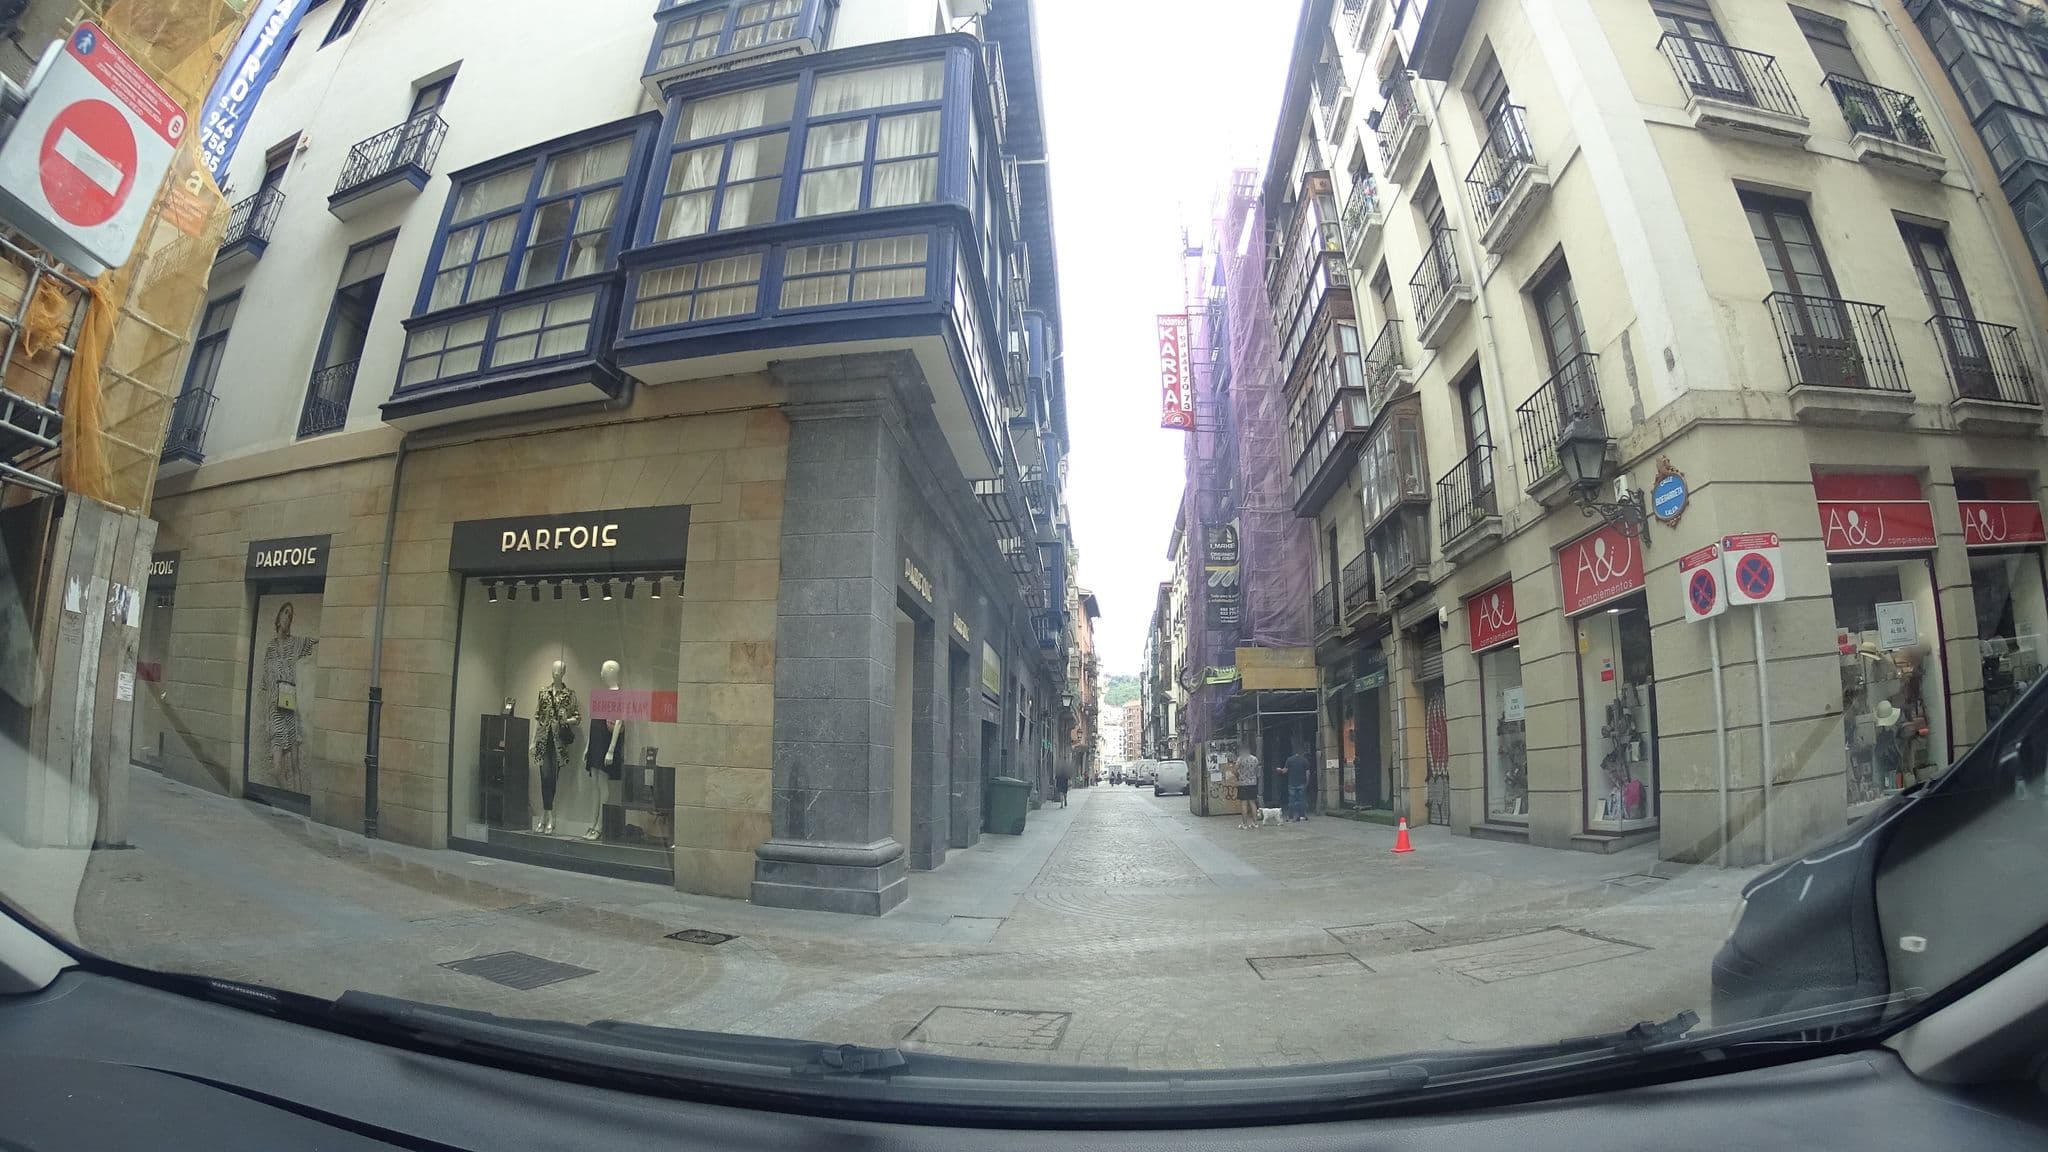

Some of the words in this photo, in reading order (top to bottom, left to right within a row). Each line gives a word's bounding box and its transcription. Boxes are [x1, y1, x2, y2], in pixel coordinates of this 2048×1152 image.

[171, 119, 181, 134] B
[210, 111, 235, 138] 946
[201, 127, 228, 155] 756
[1160, 326, 1179, 405] KARPA
[501, 524, 618, 553] PARFOIS
[1826, 506, 1884, 548] A&J
[1965, 507, 2007, 544] A&J
[256, 548, 317, 568] PARFOIS
[1578, 579, 1633, 607] complementos
